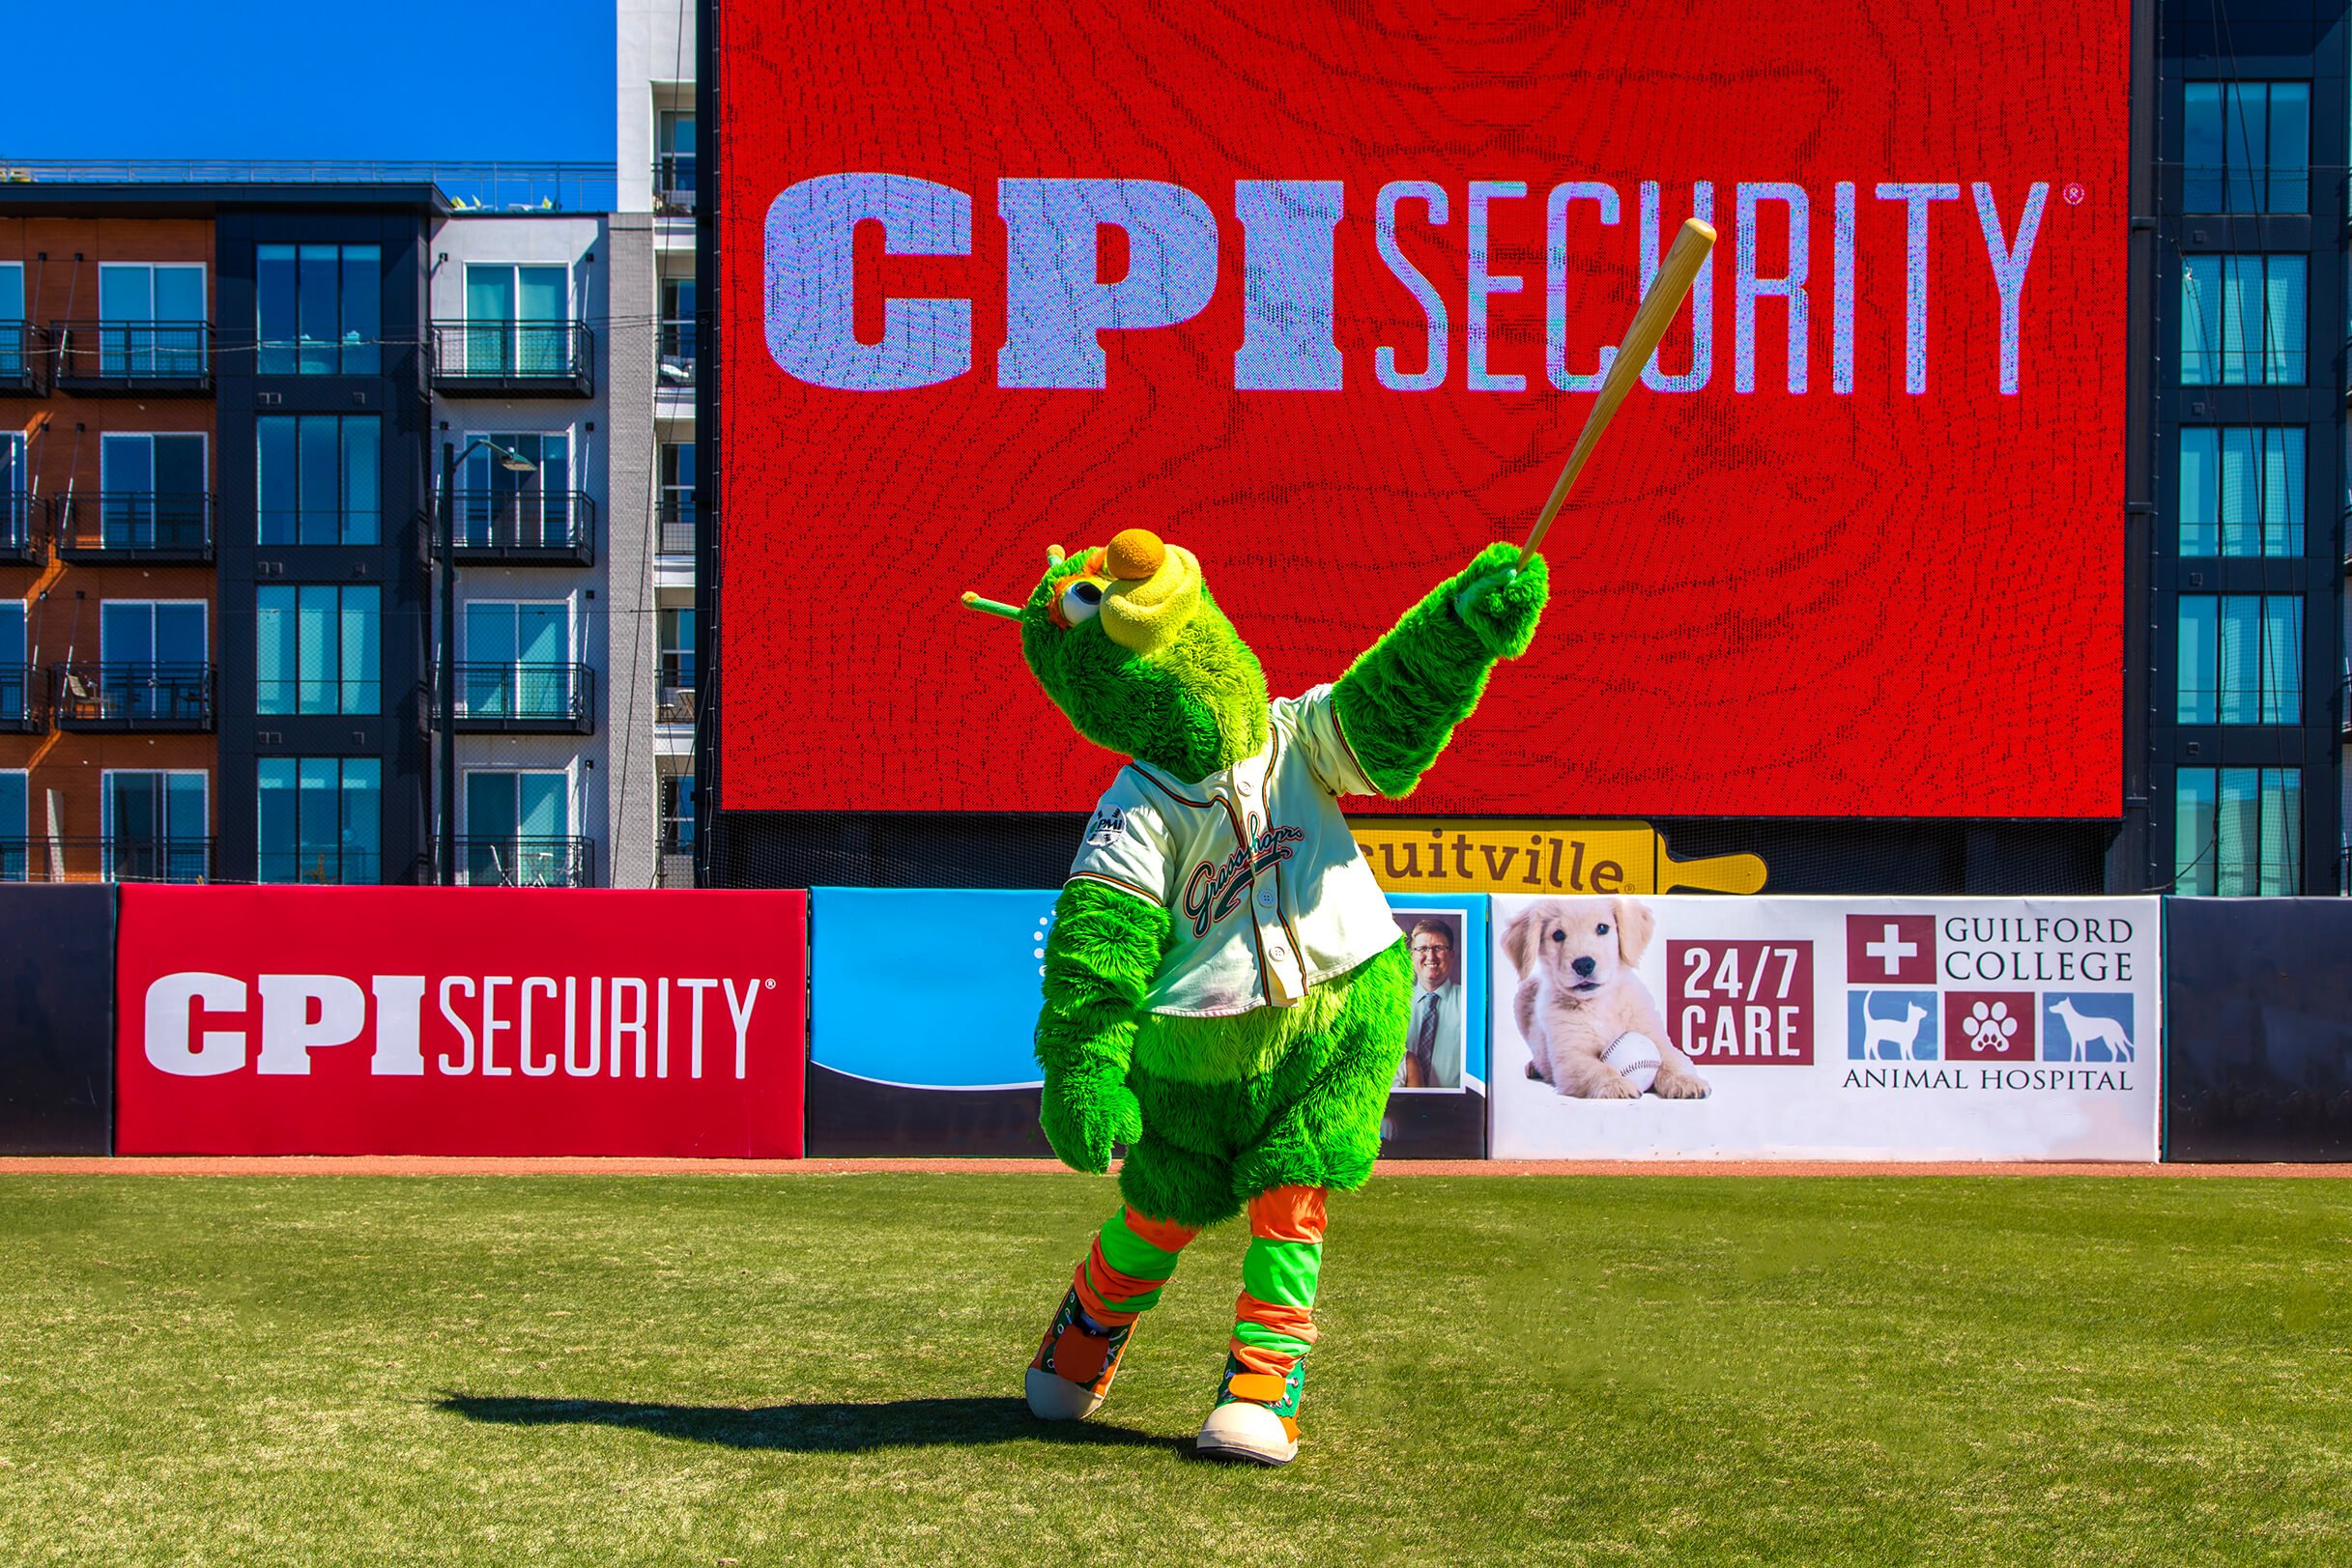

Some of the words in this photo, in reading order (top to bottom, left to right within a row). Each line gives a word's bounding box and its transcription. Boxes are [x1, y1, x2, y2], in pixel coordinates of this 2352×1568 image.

[763, 172, 1344, 391] CPI
[1374, 180, 2051, 395] SECURITY
[1357, 827, 1624, 895] uitville
[1944, 917, 2133, 944] GUILFORD
[1683, 945, 1798, 1002] 24/7
[1945, 952, 2133, 982] COLLEGE
[144, 972, 425, 1076] CPI
[438, 976, 760, 1079] SECURITY
[1681, 1005, 1800, 1057] CARE
[1842, 1069, 1968, 1090] ANIMAL
[1982, 1069, 2134, 1091] HOSPITAL
